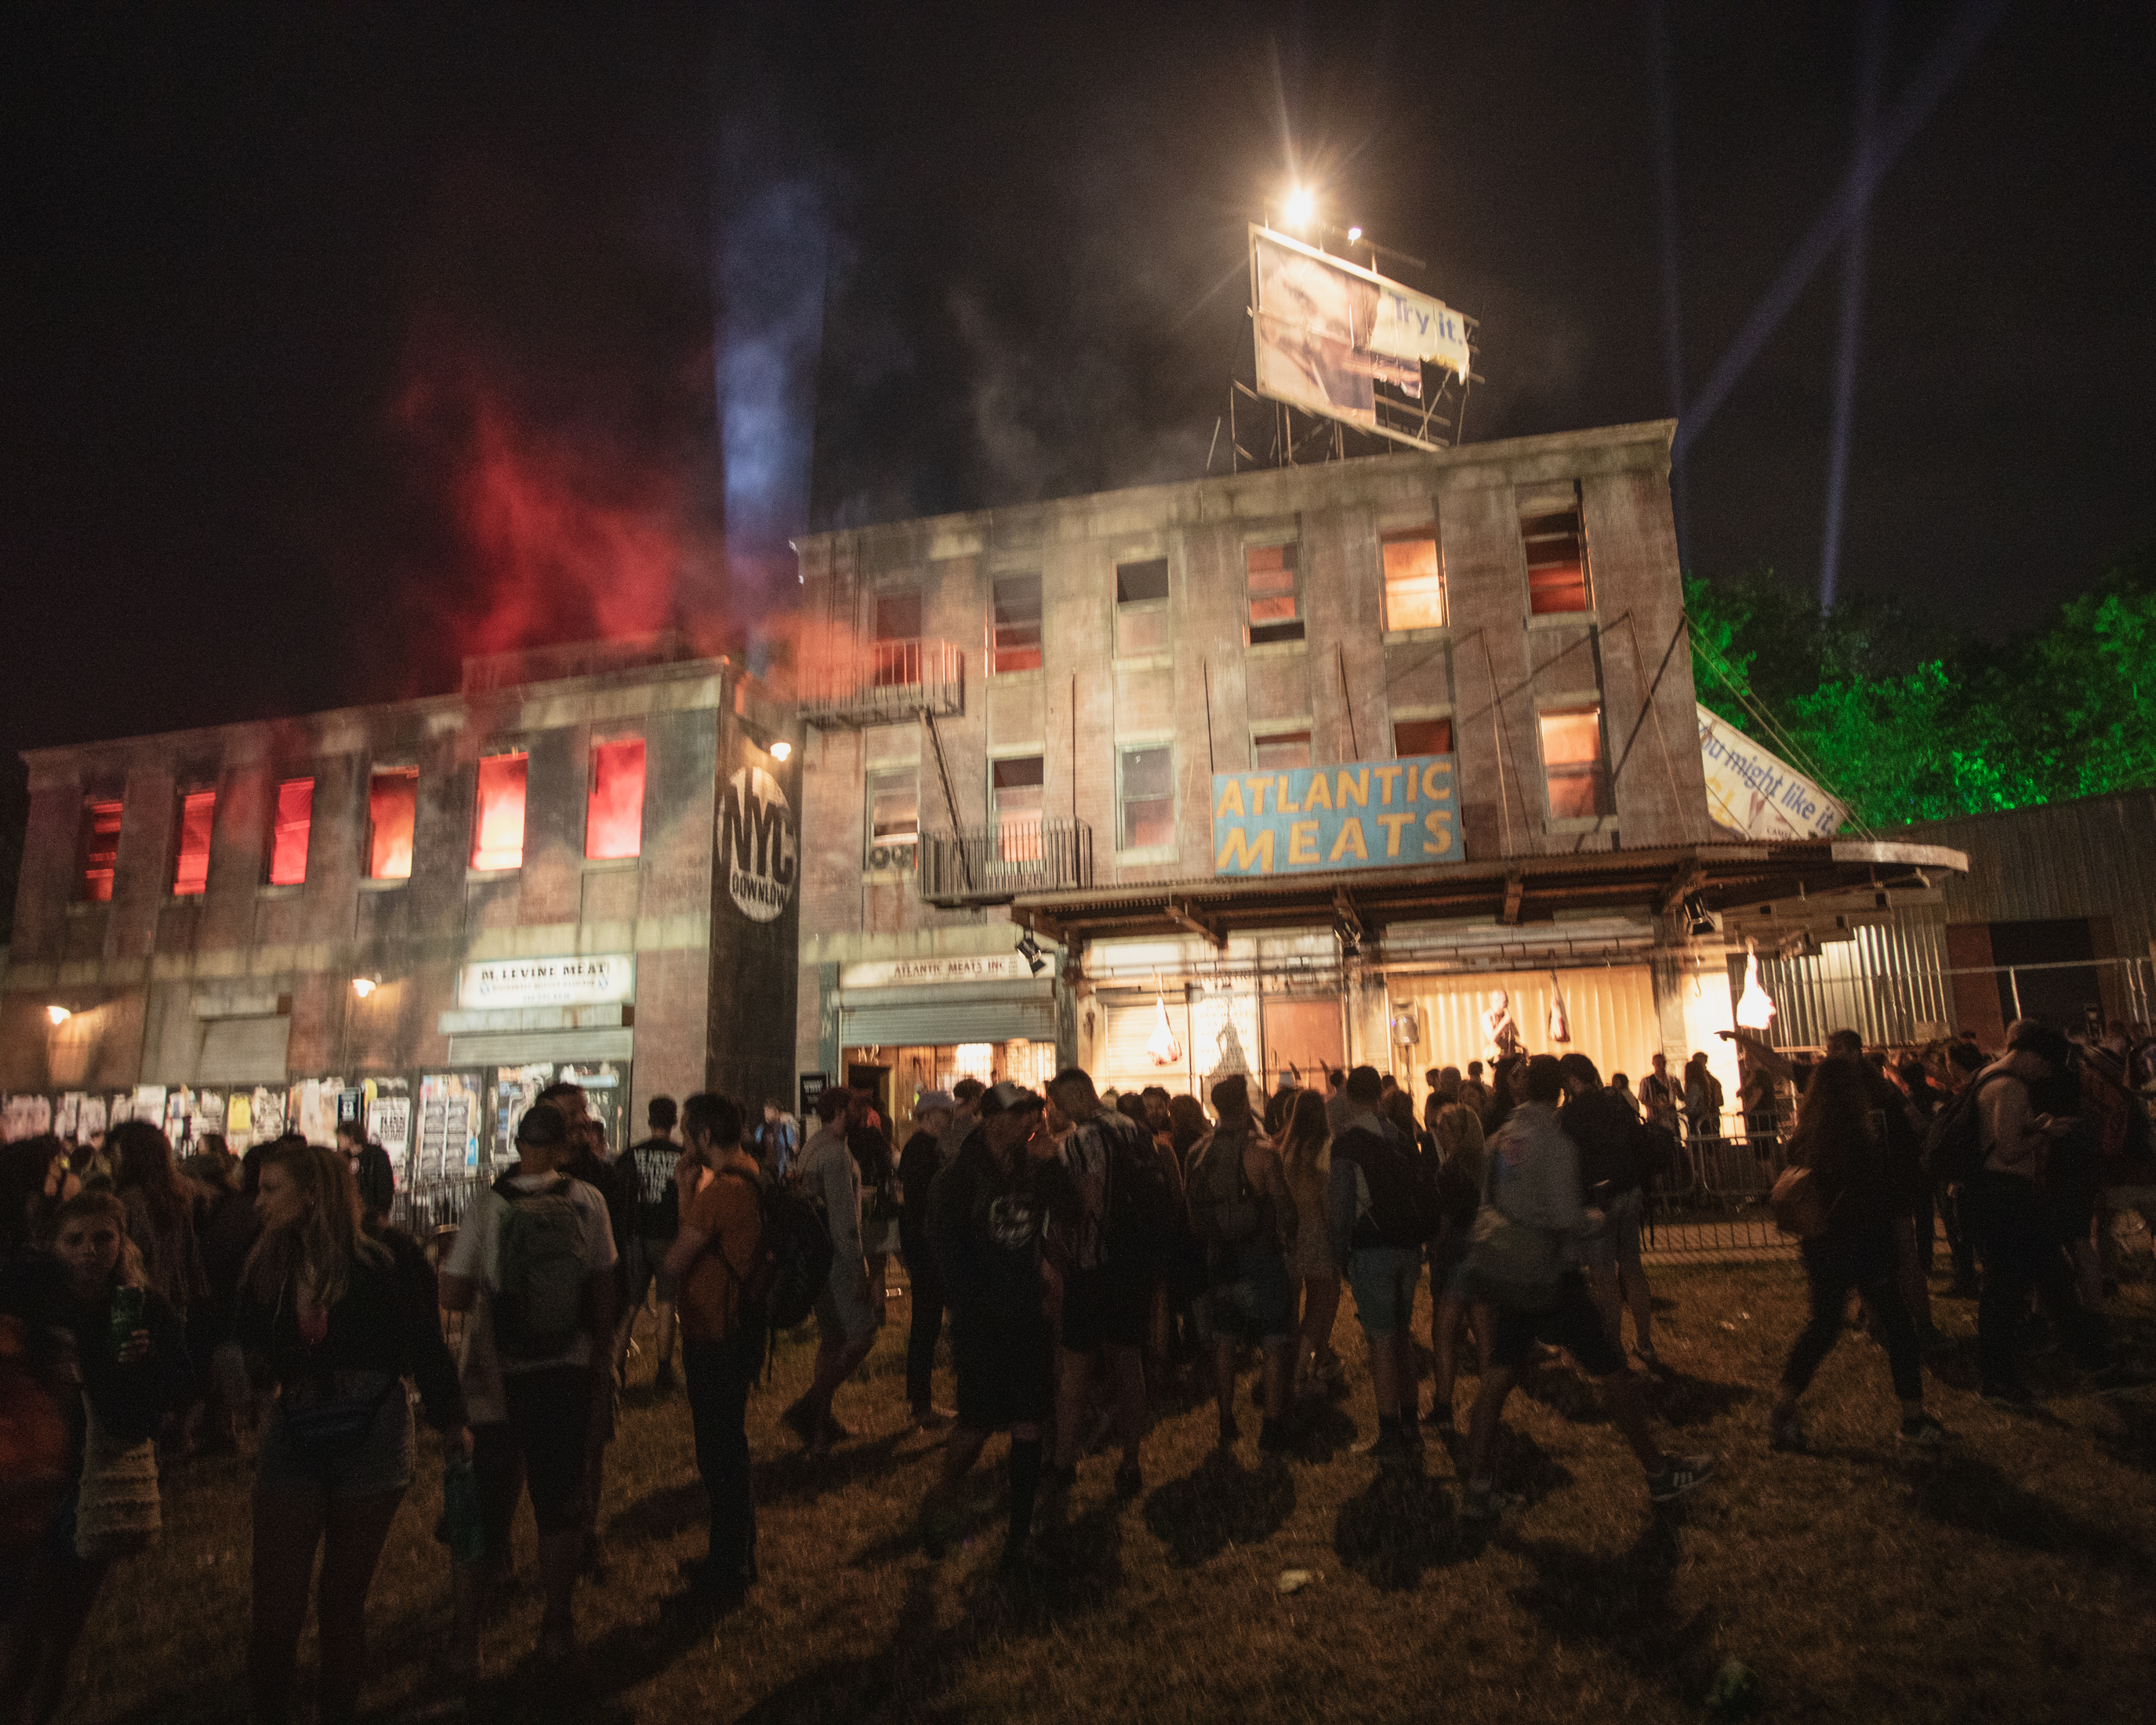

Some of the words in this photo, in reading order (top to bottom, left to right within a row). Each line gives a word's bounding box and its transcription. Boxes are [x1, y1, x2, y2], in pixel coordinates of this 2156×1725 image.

[1388, 289, 1429, 336] Try
[1439, 311, 1463, 345] it.
[1216, 761, 1451, 819] ATLANTIC
[1725, 750, 1783, 798] might
[1780, 781, 1817, 820] like
[722, 765, 796, 884] NYC
[1217, 810, 1452, 873] MEATS
[731, 870, 786, 909] DOWNLOW
[503, 964, 557, 980] LEVINE
[894, 963, 942, 979] ATLANTIC
[949, 959, 982, 973] MEATS
